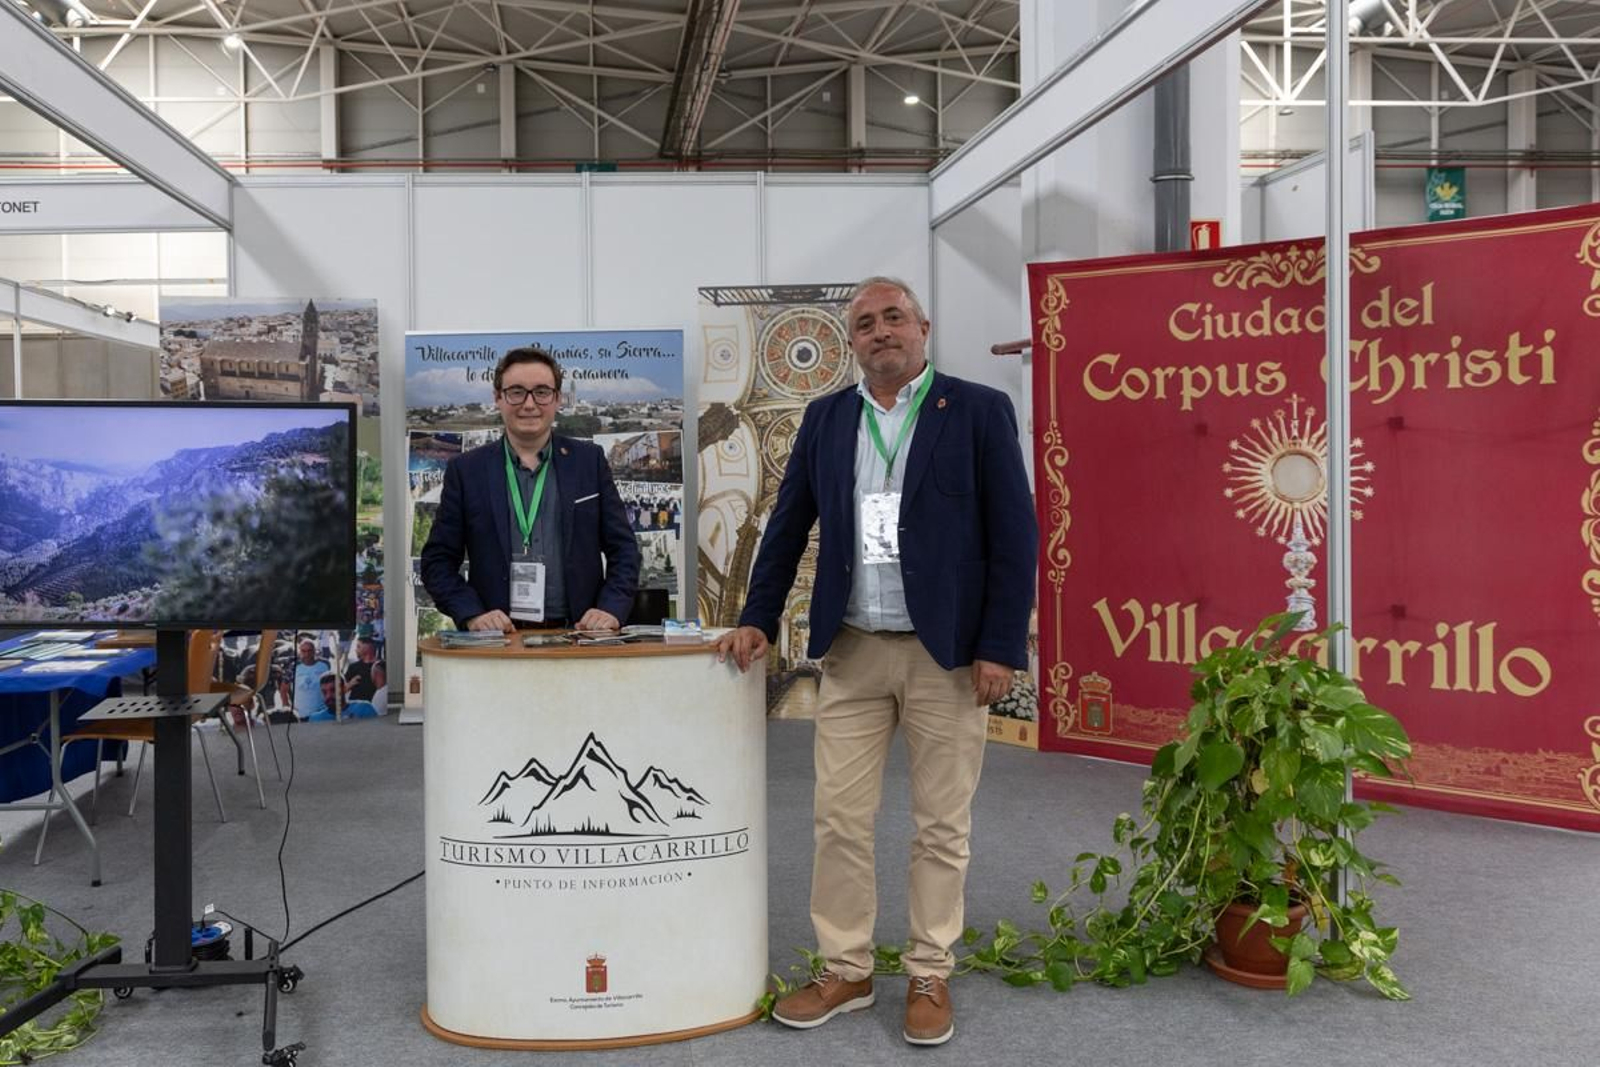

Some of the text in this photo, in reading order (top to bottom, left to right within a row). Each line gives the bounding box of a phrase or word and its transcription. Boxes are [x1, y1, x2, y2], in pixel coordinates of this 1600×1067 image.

[0, 201, 41, 213] ONET
[1361, 282, 1434, 329] del
[598, 347, 611, 358] su
[465, 366, 477, 382] lo
[571, 368, 629, 380] enamora
[1083, 353, 1287, 410] Corpus
[440, 832, 749, 865] TURISMO VILLACARRILLO
[504, 870, 683, 890] PUNTO DE INFORMACIÓN
